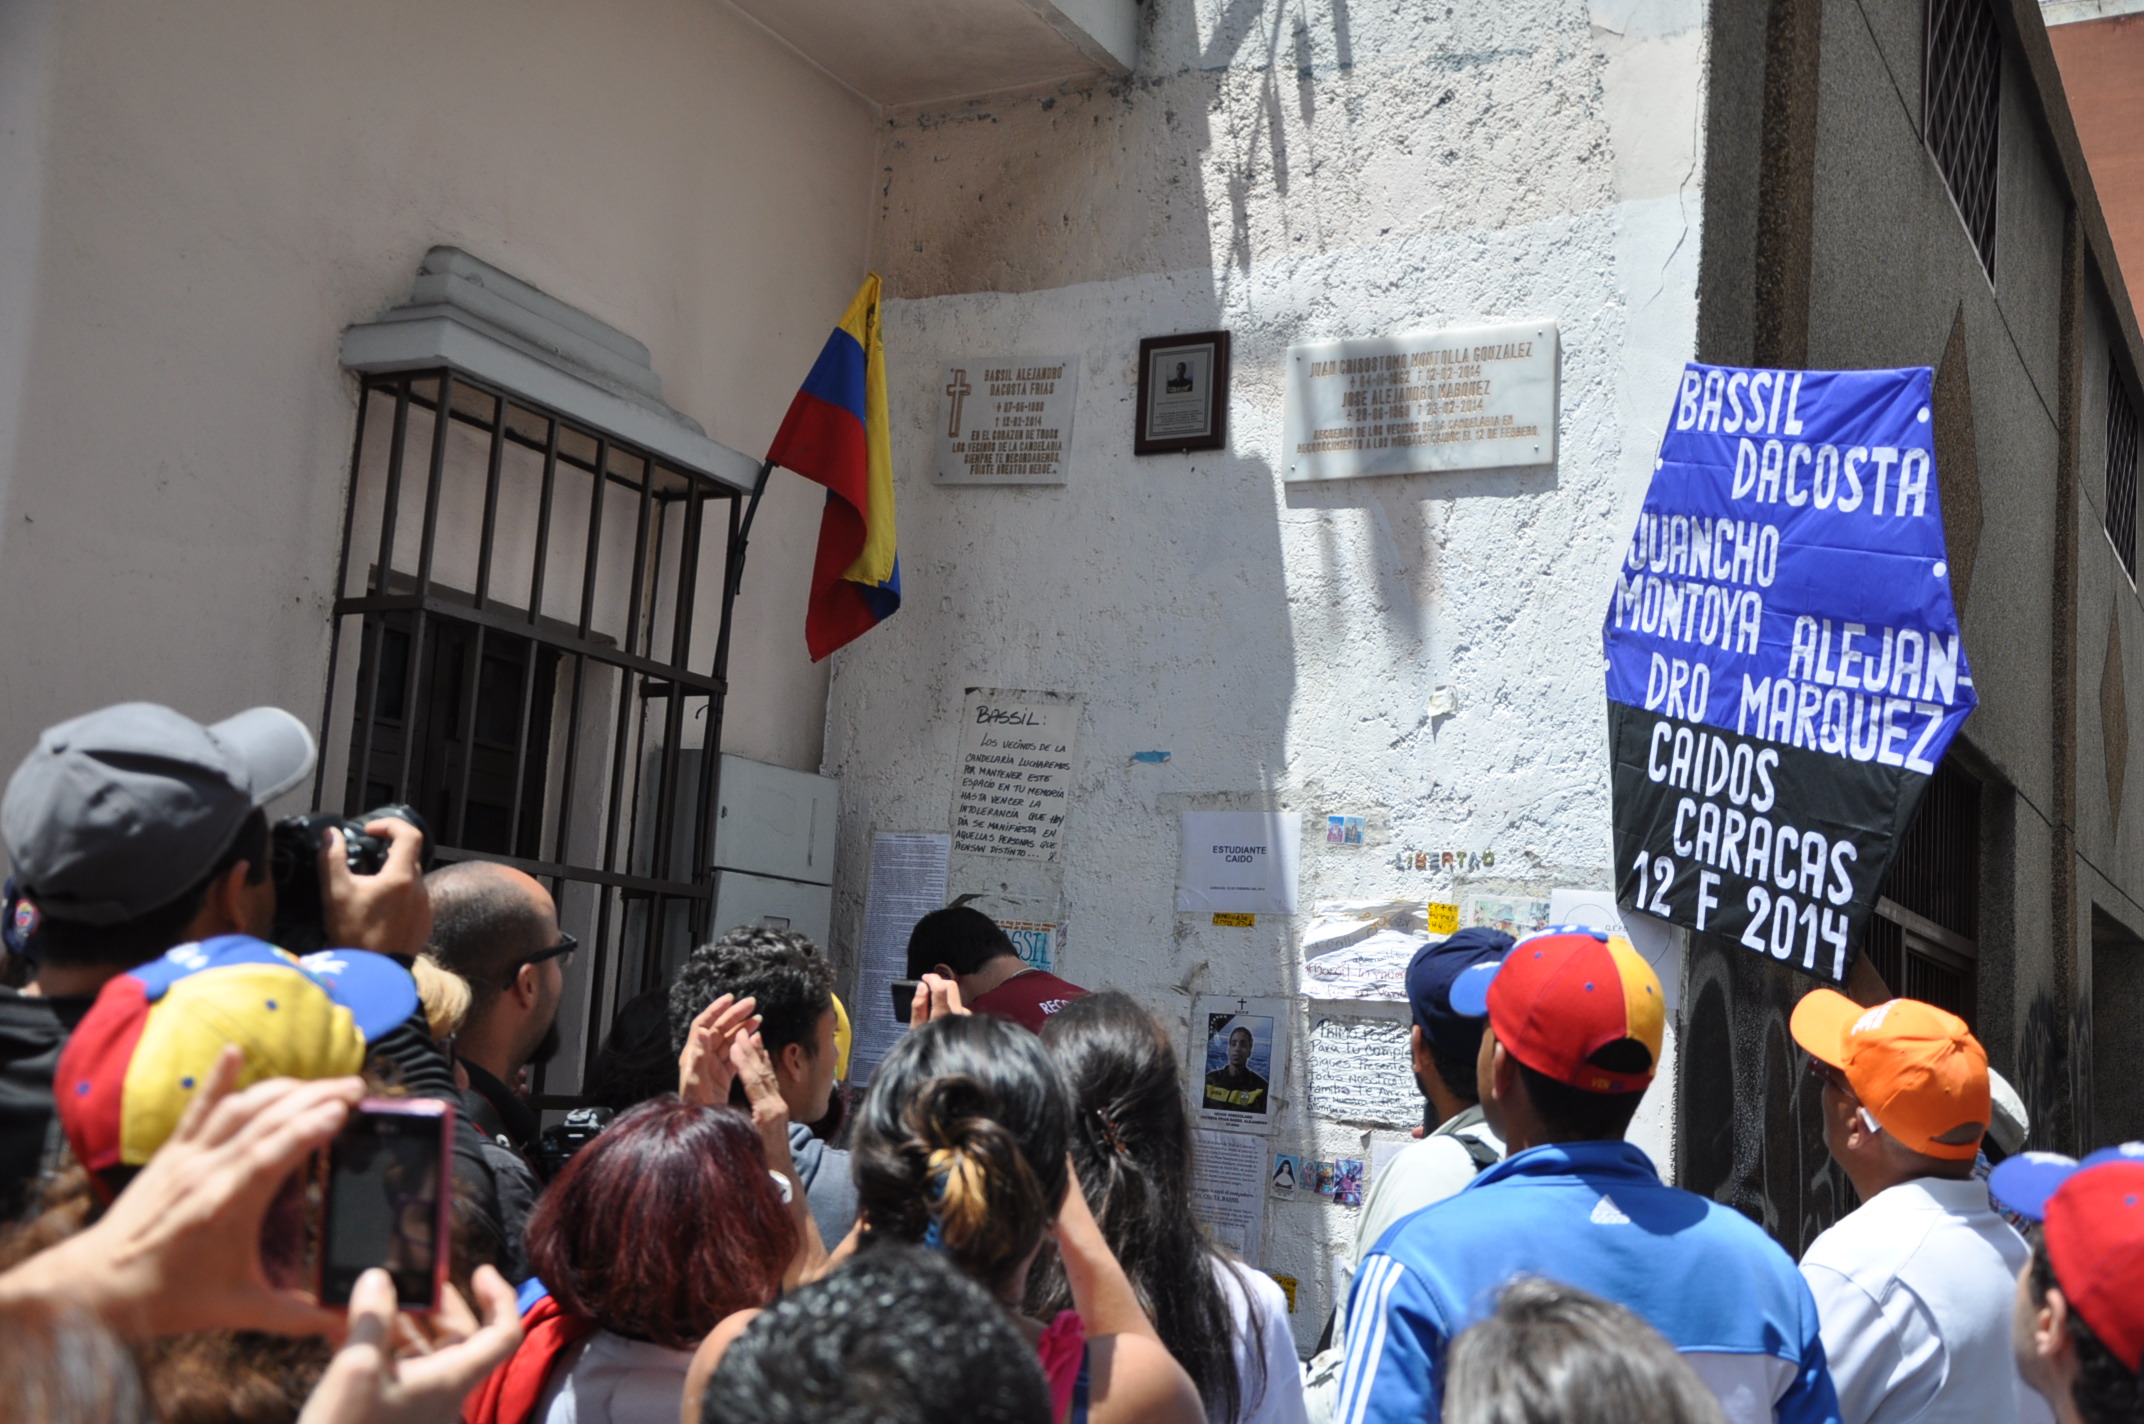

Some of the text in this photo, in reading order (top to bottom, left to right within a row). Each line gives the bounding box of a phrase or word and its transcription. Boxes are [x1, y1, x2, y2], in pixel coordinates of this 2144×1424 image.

[1309, 342, 1533, 378] JUAN CRISOSTOMO MONTOLLA GONZALEZ
[984, 366, 1063, 382] BASSIL ALEJANDRO
[990, 382, 1055, 396] DACOSTA FRIAS
[1341, 390, 1368, 408] JOSE
[1371, 384, 1435, 406] ALEJANDRO
[1677, 369, 1804, 436] BASSIL
[971, 428, 1059, 441] EN EL CORAZON DE TODOS
[952, 442, 966, 453] LOS
[967, 441, 997, 453] VECINOS
[964, 453, 993, 465] SIEMPRE
[995, 453, 1004, 464] TE
[1731, 437, 1931, 517] DACOSTA
[1627, 512, 1780, 588] JUANCHO
[1614, 571, 1763, 655] MONTOYA
[1644, 652, 1944, 776] DRO MARQUEZ
[1039, 743, 1051, 752] DE
[1055, 745, 1066, 753] LA
[1018, 758, 1071, 771] LUCHAREMOS
[1648, 722, 1779, 813] CAIDOS
[978, 766, 1022, 780] MANTENER
[998, 783, 1011, 791] EN
[1013, 784, 1026, 794] TU
[961, 791, 1041, 808] HASTA VENCER LA
[1028, 812, 1045, 822] QUE
[955, 830, 1058, 850] AQUELLAS PERSONAS QUE
[1042, 829, 1057, 838] EN
[1212, 845, 1267, 855] ESTUDIANTE
[1673, 798, 1858, 906] CARACAS
[1225, 854, 1253, 864] CAIDO
[1632, 850, 1849, 982] 12 F 2014
